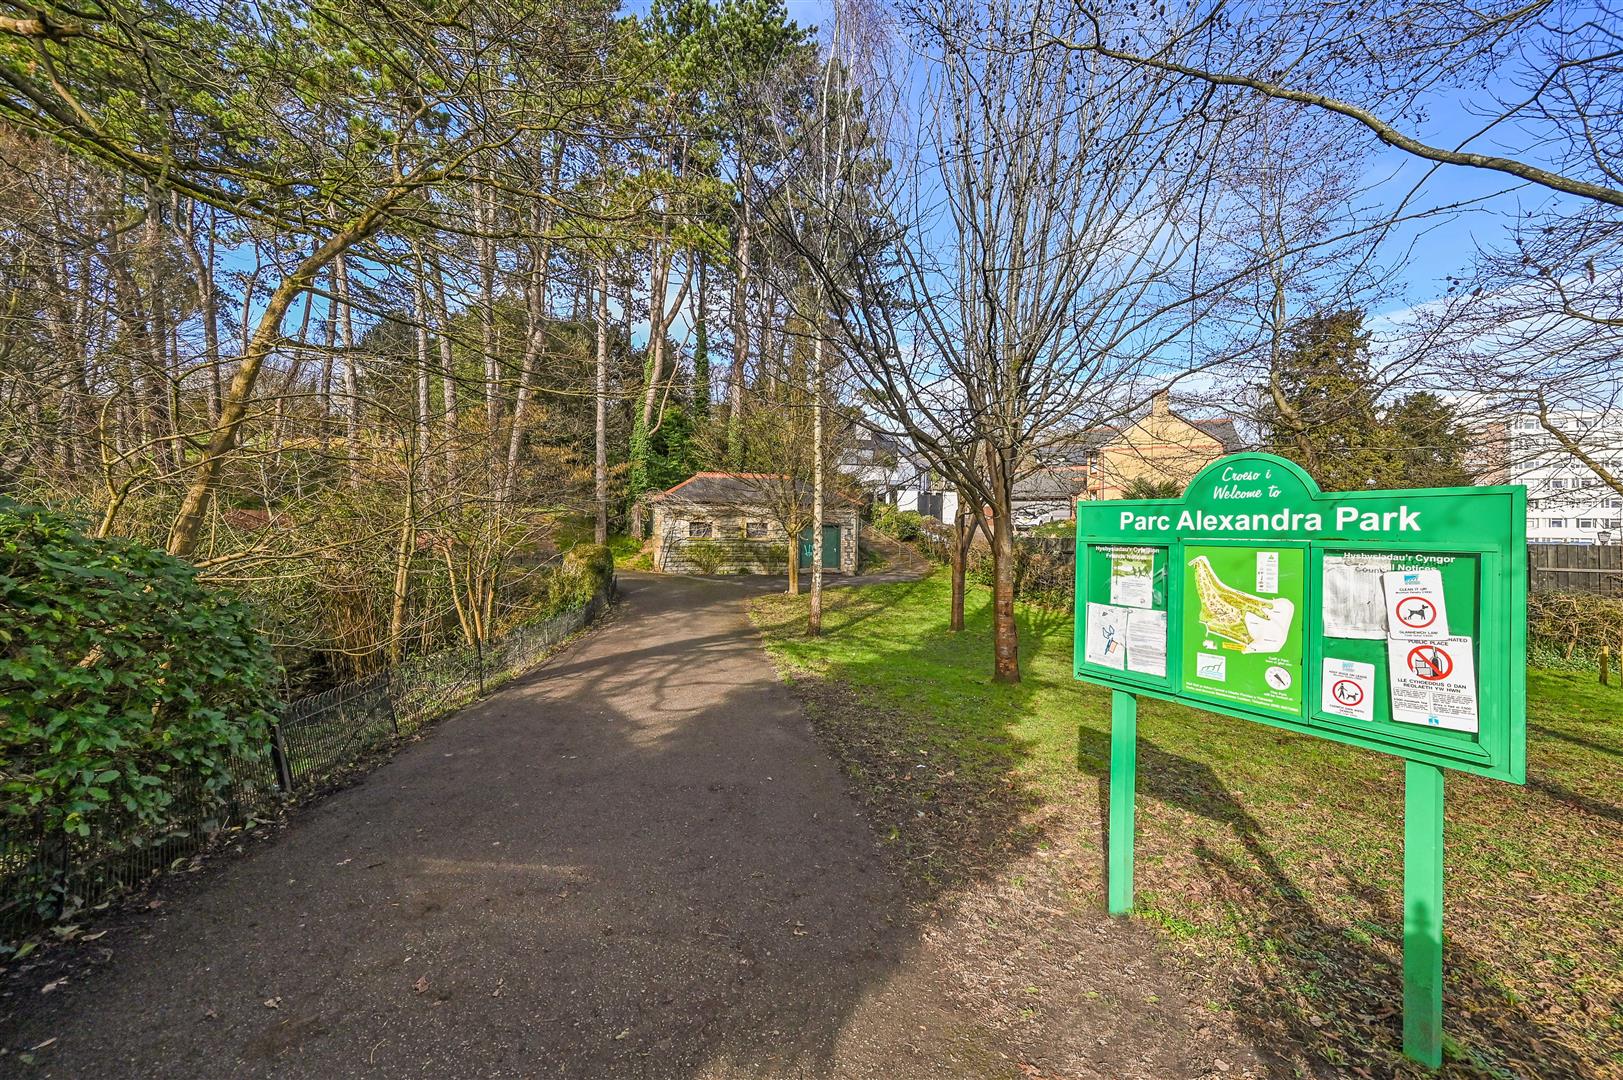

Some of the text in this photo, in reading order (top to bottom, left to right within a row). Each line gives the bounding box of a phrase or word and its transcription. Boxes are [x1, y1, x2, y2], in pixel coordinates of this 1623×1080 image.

[1222, 466, 1272, 482] Croeso i
[1213, 484, 1282, 500] Welcome to
[1120, 505, 1421, 532] Parc Alexandra Park
[1415, 554, 1456, 565] Cyngor
